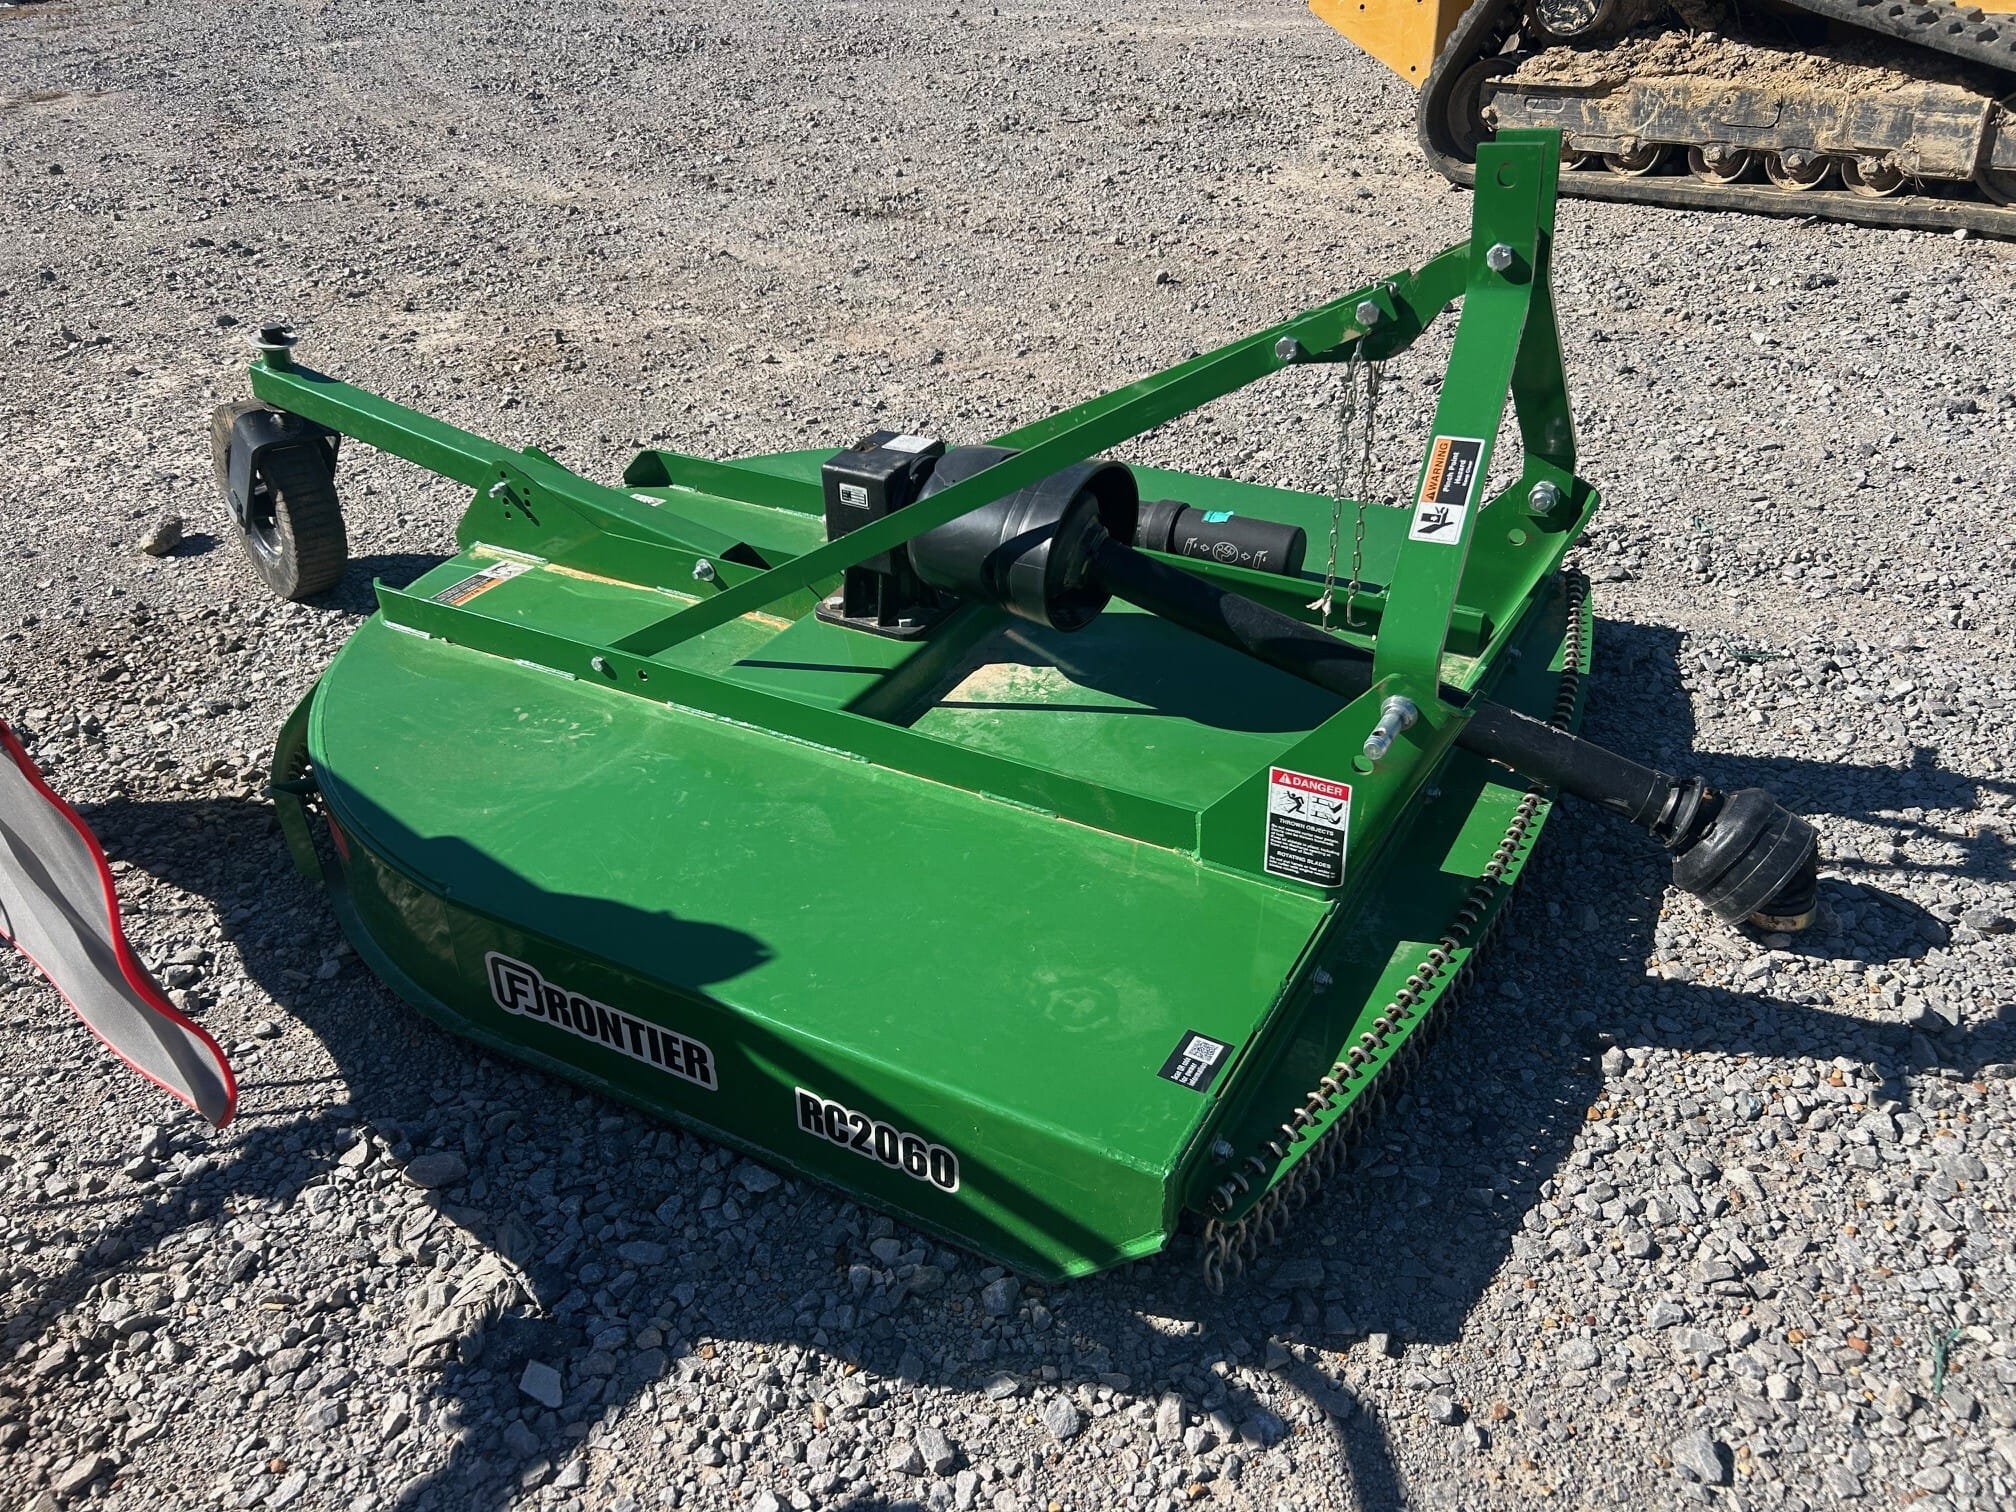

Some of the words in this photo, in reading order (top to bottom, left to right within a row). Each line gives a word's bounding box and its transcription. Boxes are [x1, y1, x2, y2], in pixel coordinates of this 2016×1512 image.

[1429, 442, 1449, 492] WARNING
[1447, 452, 1460, 471] Point
[1453, 459, 1467, 485] Hazard
[1292, 776, 1343, 797] DANGER
[1279, 818, 1306, 829] THROWN
[1305, 825, 1334, 837] OBJECTS
[1276, 850, 1306, 863] ROTATING
[1306, 858, 1332, 870] BLADES
[489, 954, 715, 1088] FRONTIER
[797, 1089, 958, 1191] RC2060
